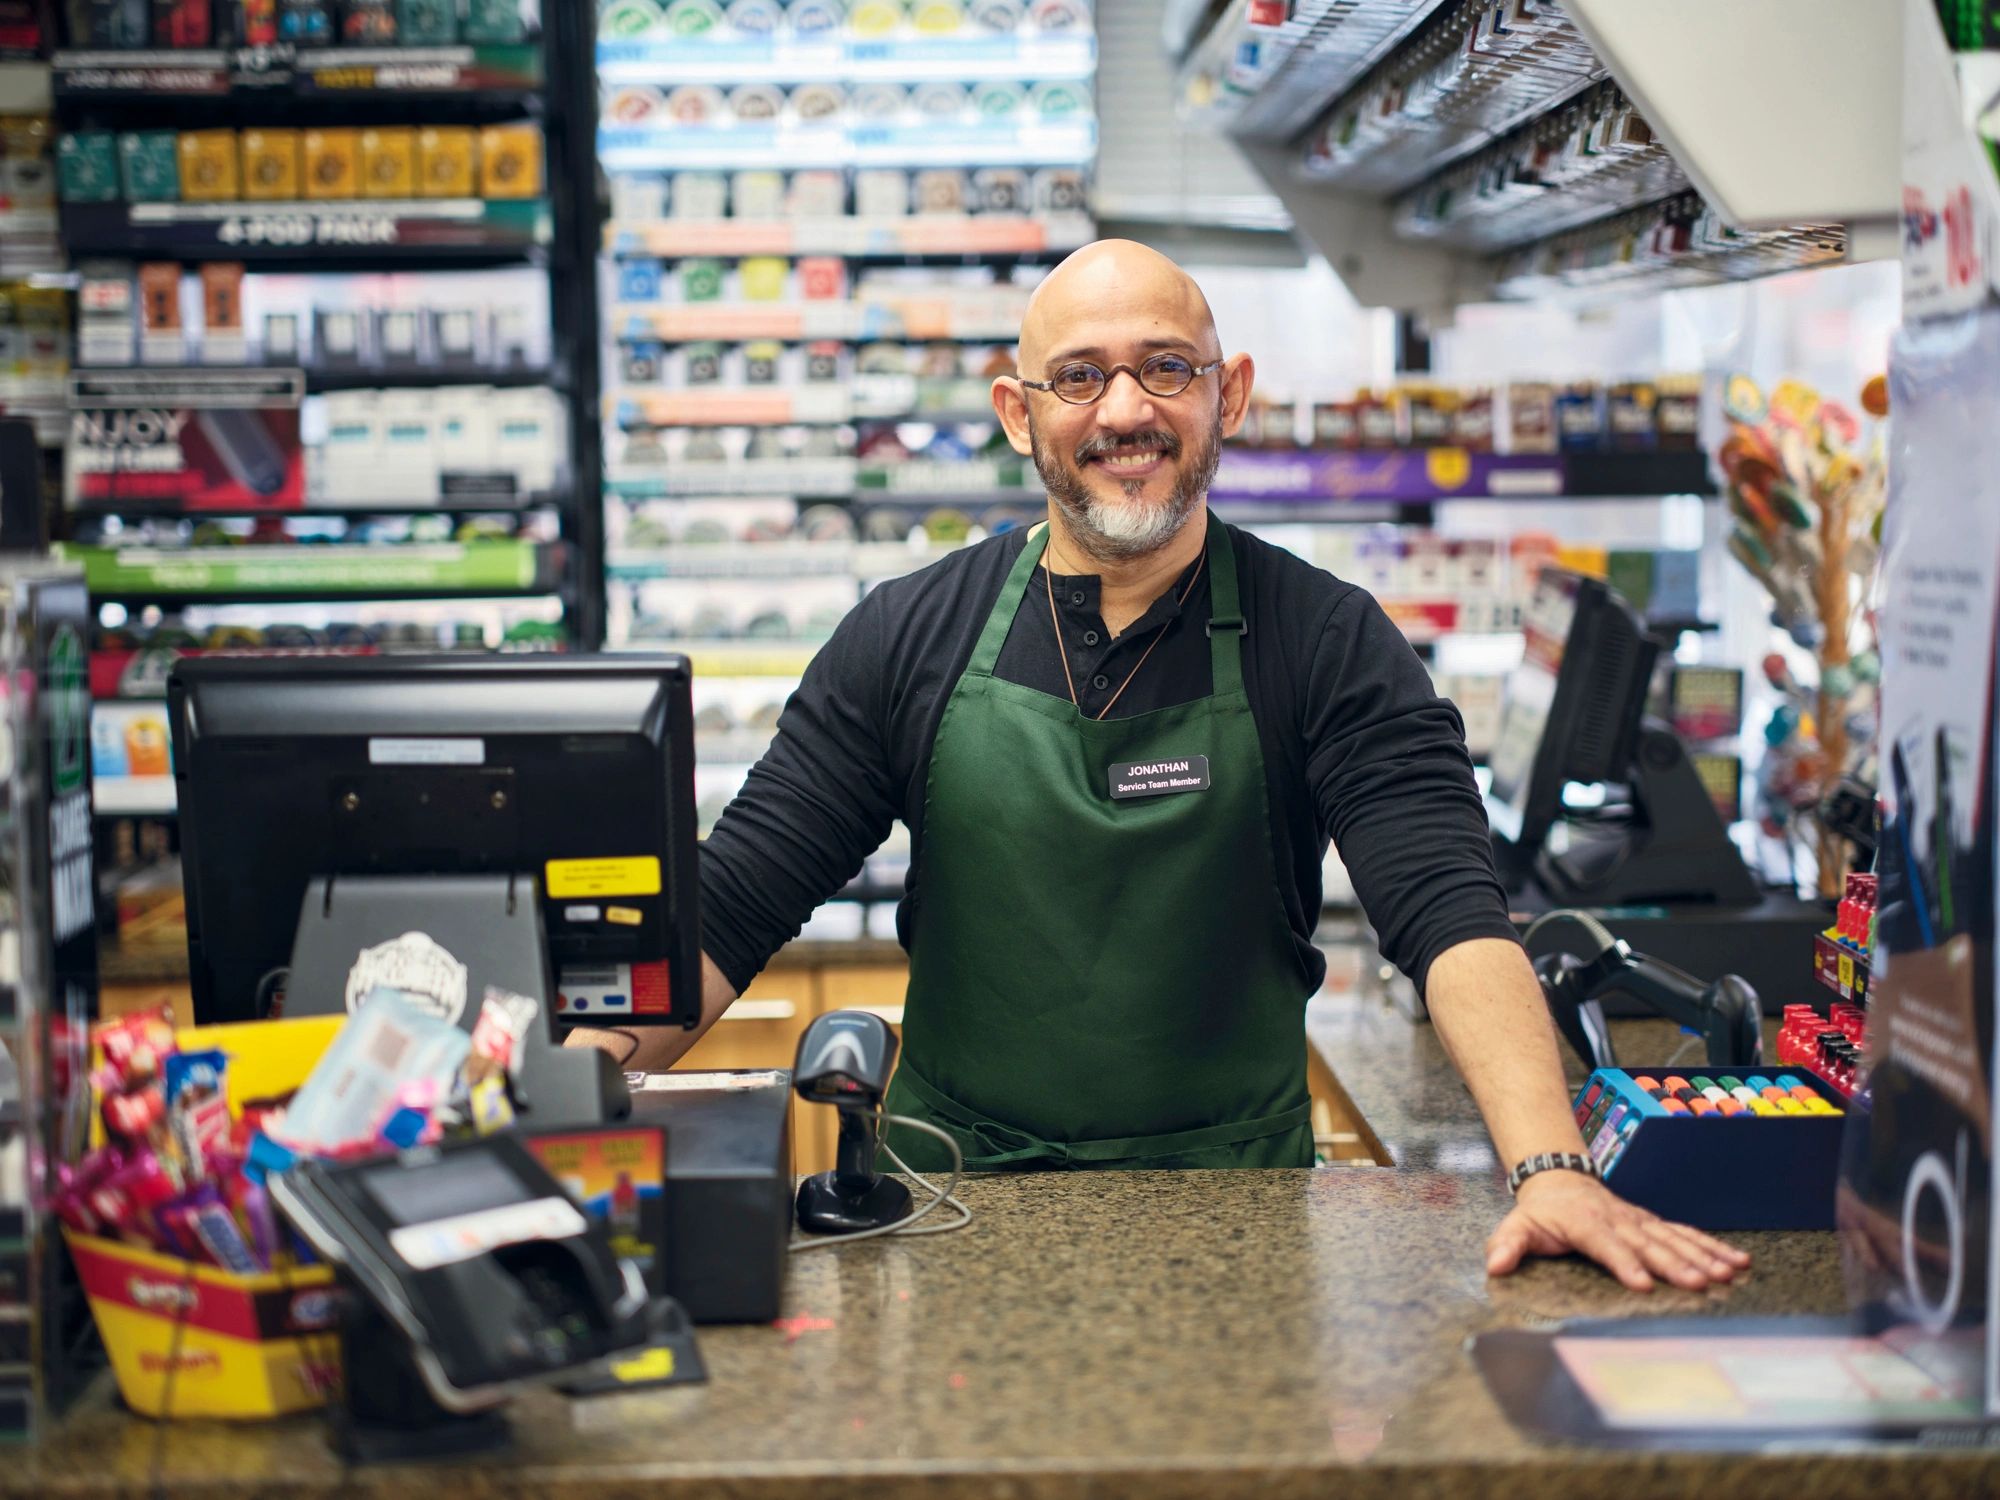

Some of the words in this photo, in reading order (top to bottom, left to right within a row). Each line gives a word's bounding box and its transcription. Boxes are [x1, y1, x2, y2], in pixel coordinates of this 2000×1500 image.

[70, 409, 187, 447] NJOY
[1128, 761, 1189, 777] JONATHAN
[1118, 782, 1148, 792] Service
[1148, 781, 1169, 790] Team
[1169, 777, 1201, 787] Member
